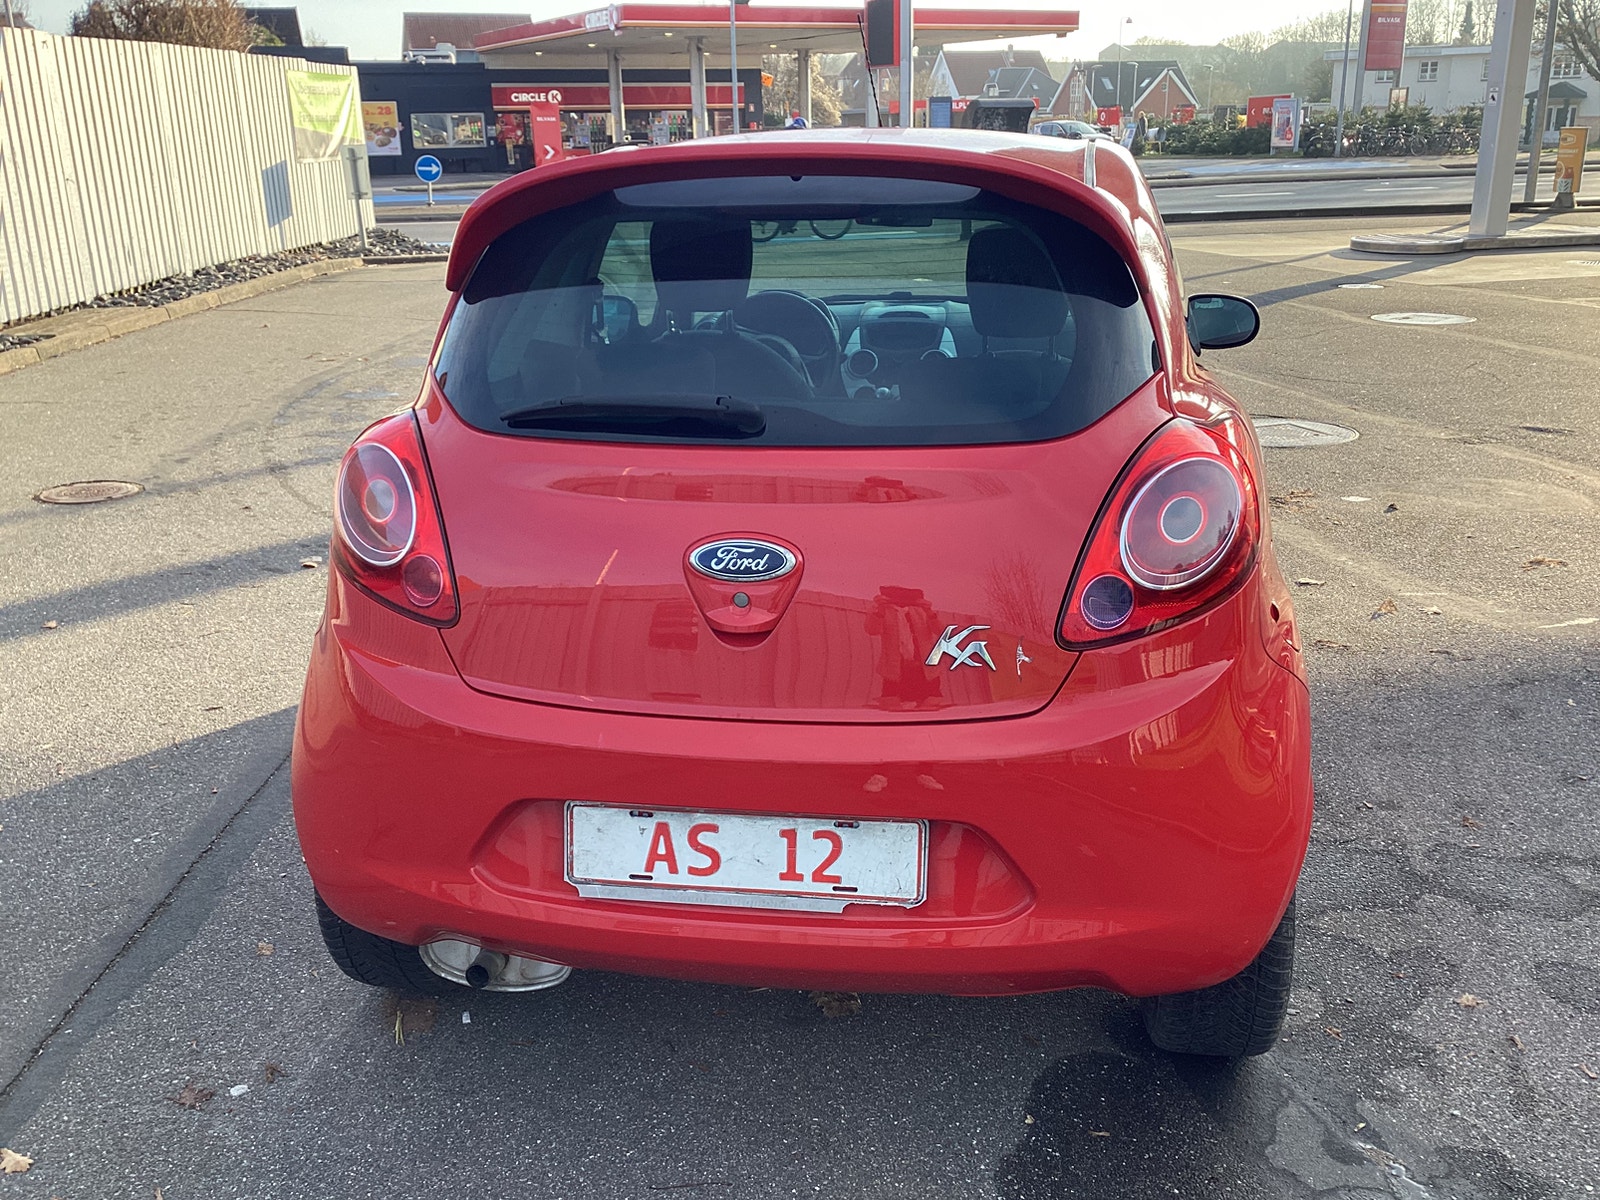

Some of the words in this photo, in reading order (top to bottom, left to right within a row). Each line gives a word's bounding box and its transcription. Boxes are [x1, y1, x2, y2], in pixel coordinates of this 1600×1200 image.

[511, 92, 547, 102] CIRCLE
[549, 91, 561, 103] K
[709, 545, 770, 572] Ford
[643, 820, 723, 878] AS
[778, 827, 844, 885] 12
